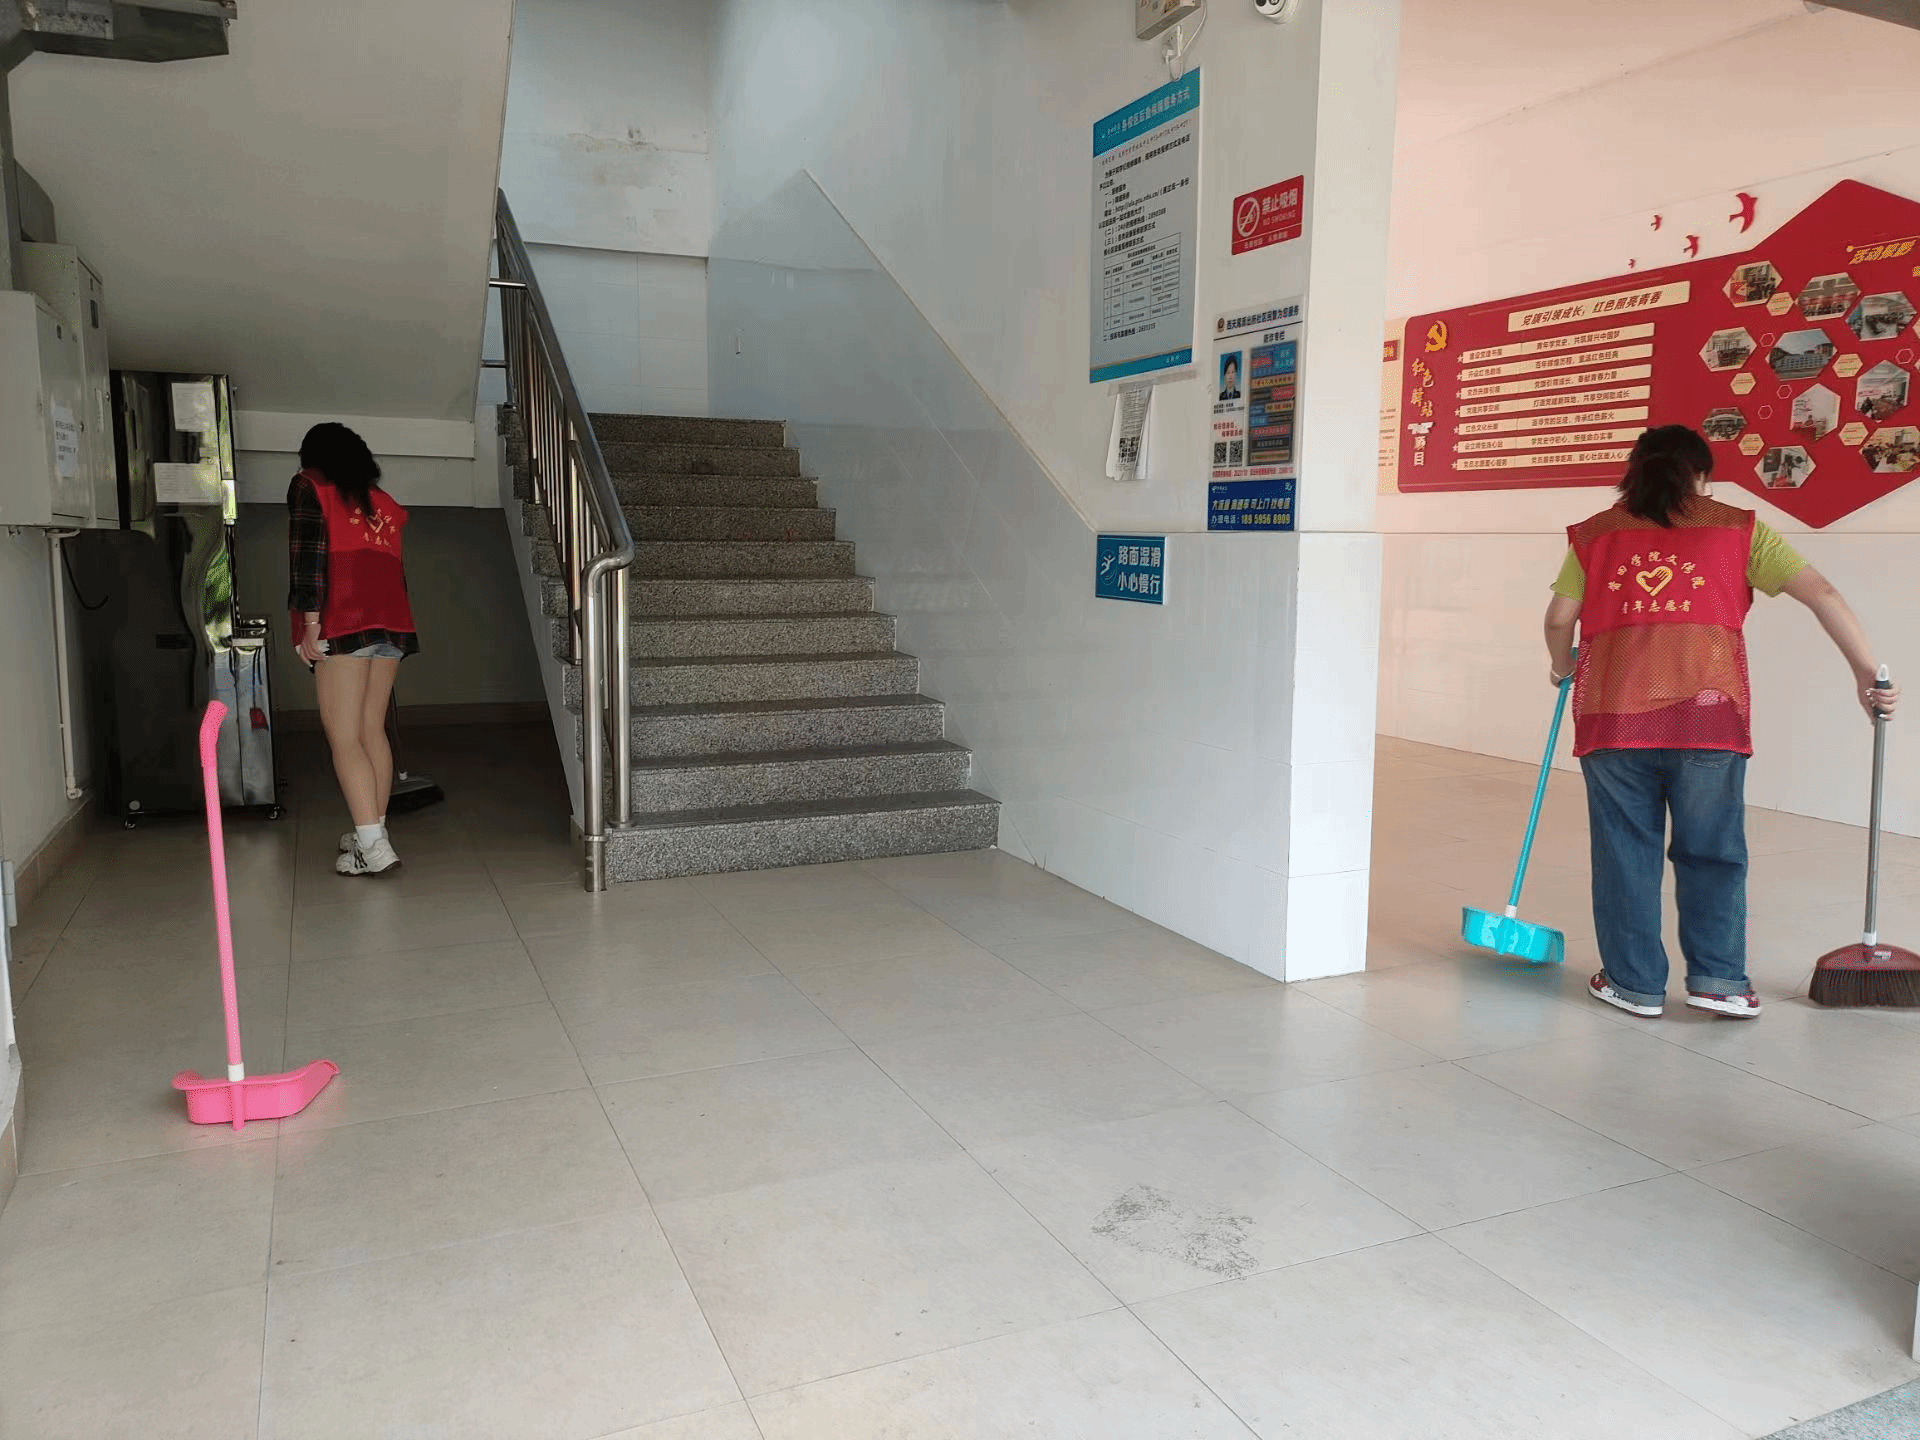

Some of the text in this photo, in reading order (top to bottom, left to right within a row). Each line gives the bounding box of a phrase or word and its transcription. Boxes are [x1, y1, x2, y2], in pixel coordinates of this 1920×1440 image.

[1262, 188, 1298, 214] 禁止吸烟
[1119, 545, 1161, 568] 路面湿滑
[1117, 572, 1160, 595] 小心慢行
